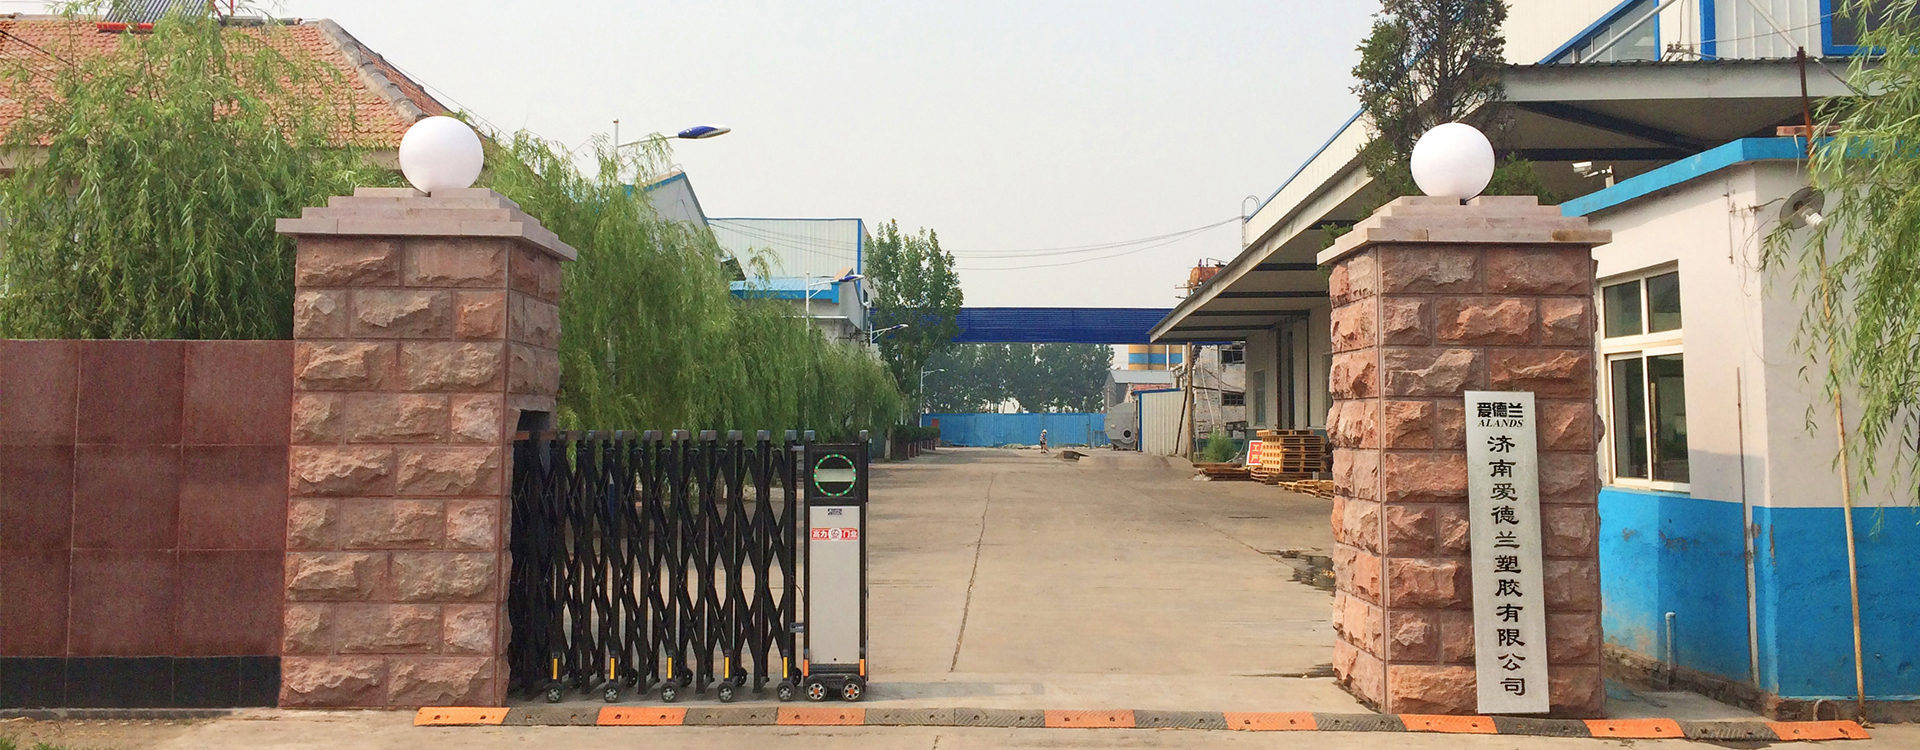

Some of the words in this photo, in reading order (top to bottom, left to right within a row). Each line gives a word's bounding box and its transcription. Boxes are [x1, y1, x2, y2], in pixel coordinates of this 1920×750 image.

[1477, 402, 1523, 417] 爱德兰
[1478, 419, 1523, 428] ALANDS
[1487, 435, 1526, 696] 济南爱德兰塑胶有限公司
